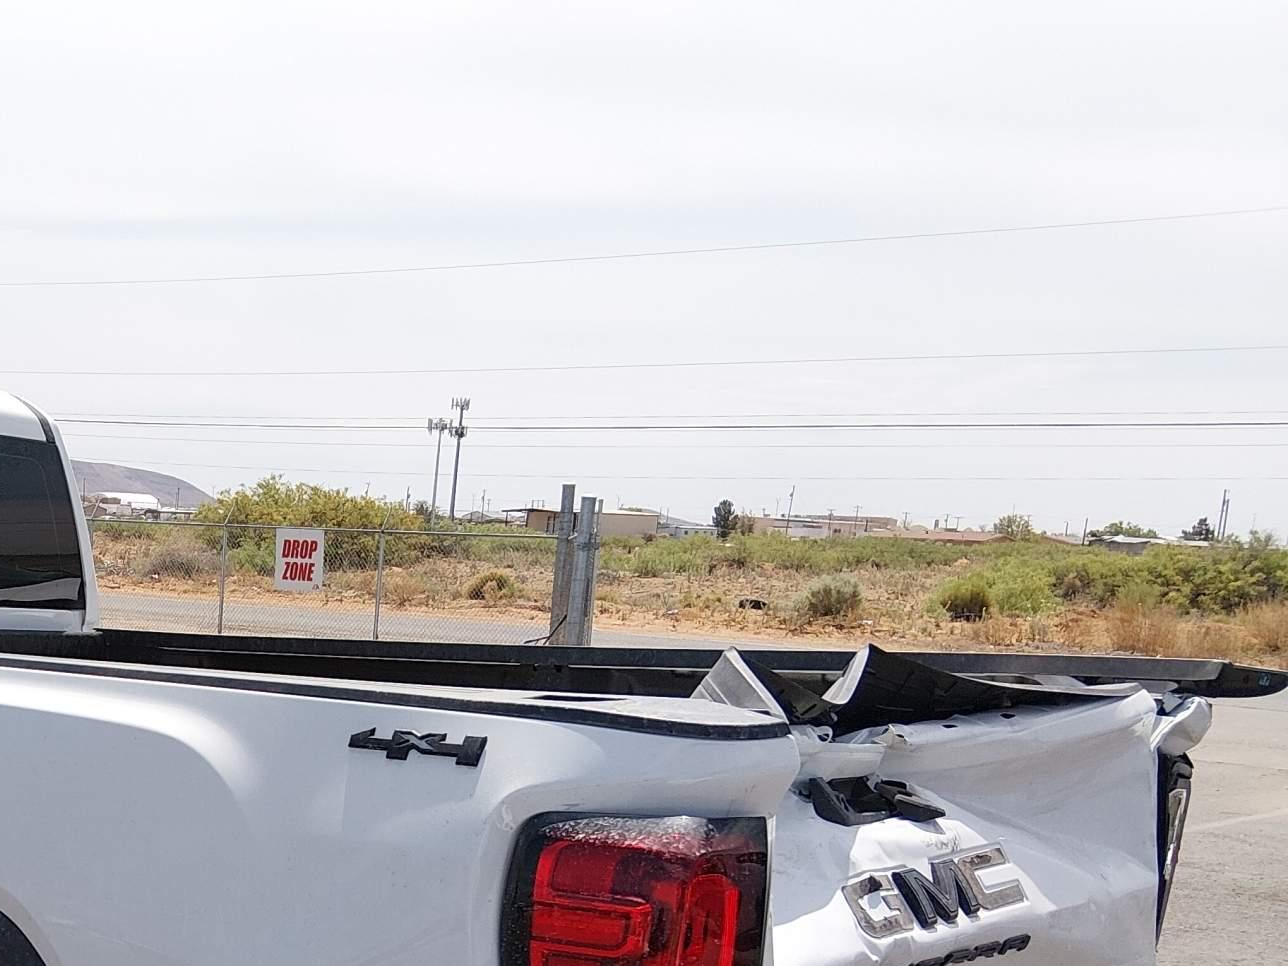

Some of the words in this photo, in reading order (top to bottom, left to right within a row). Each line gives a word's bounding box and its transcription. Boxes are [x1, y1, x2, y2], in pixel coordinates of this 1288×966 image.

[282, 539, 318, 559] DROP
[282, 561, 315, 582] ZONE
[841, 844, 1029, 939] GMC
